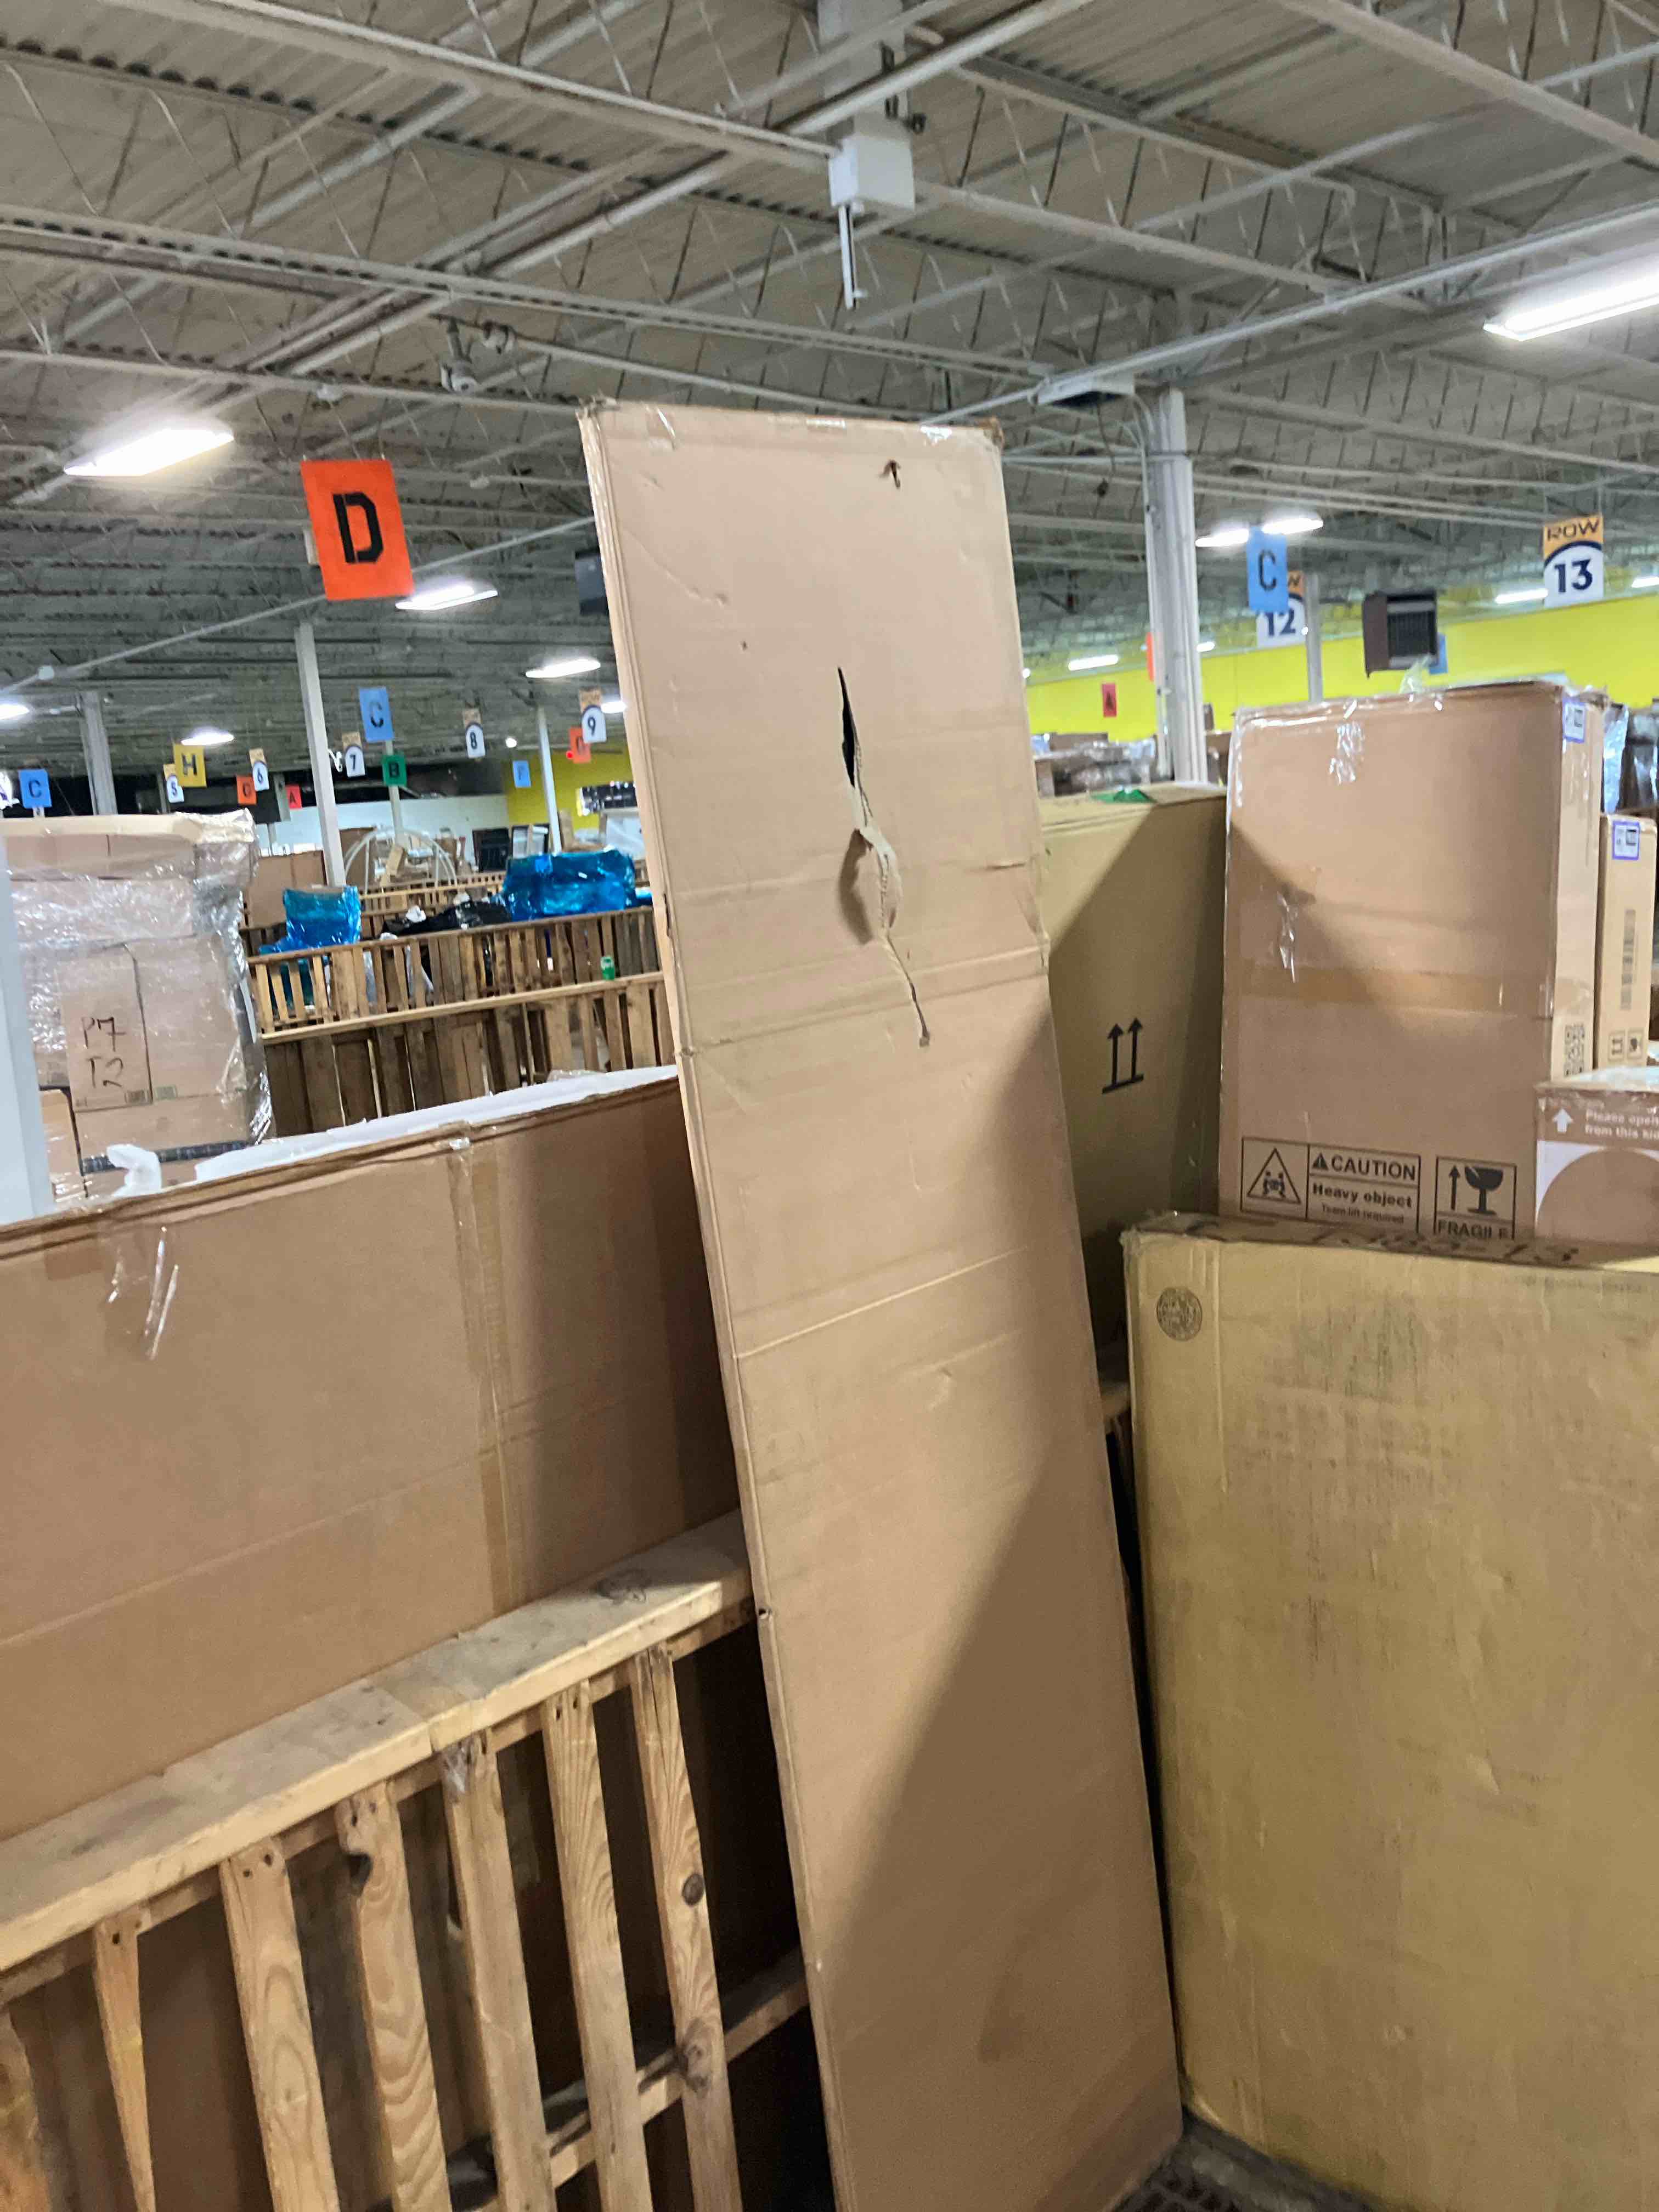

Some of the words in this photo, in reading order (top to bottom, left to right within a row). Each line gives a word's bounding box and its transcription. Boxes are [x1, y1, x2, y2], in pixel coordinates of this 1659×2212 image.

[332, 492, 383, 563] D
[1547, 519, 1599, 541] ROW
[1258, 550, 1277, 591] C
[1554, 559, 1593, 593] 13
[1265, 608, 1296, 636] 12
[369, 701, 384, 727] C
[587, 715, 596, 736] 9
[470, 732, 478, 750] 8
[182, 754, 198, 776] H
[349, 754, 357, 771] 7
[28, 779, 42, 798] C
[257, 771, 263, 784] 6
[1585, 1124, 1612, 1137] from
[1616, 1126, 1638, 1139] this
[1331, 1154, 1416, 1181] CAUTION
[1312, 1182, 1358, 1203] Heavy
[1363, 1189, 1412, 1209] object
